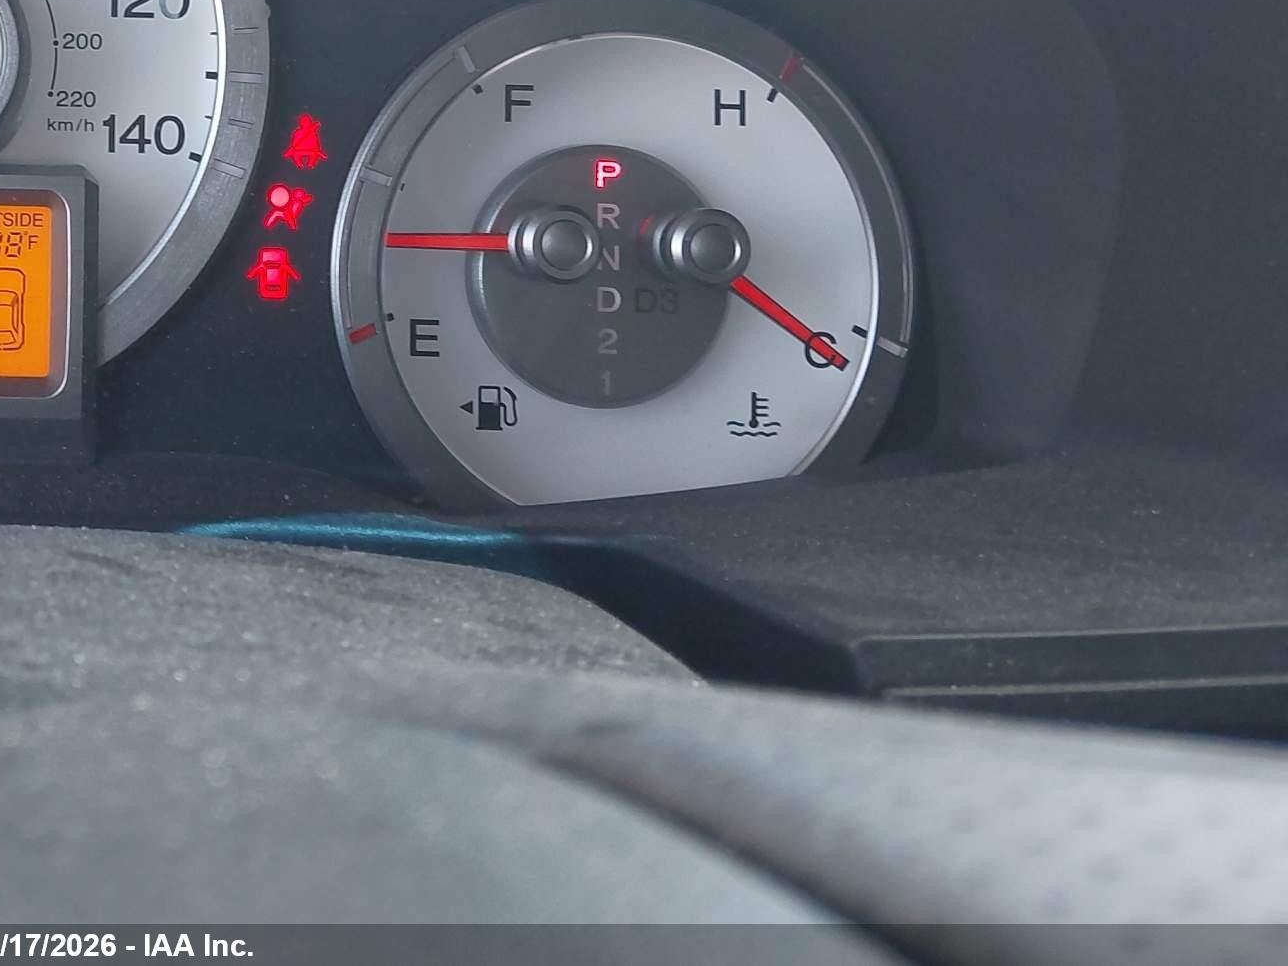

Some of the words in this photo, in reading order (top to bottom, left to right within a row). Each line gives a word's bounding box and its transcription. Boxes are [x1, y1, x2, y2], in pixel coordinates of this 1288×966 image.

[62, 34, 102, 50] 200
[56, 92, 95, 107] 220
[504, 84, 534, 122] F
[714, 90, 746, 126] H
[47, 117, 94, 132] km/h
[102, 114, 185, 153] 140
[595, 160, 622, 188] P
[597, 203, 619, 229] R
[598, 288, 621, 313] D
[411, 319, 440, 357] E
[598, 329, 618, 355] 2
[805, 332, 836, 368] C
[602, 371, 611, 395] 1
